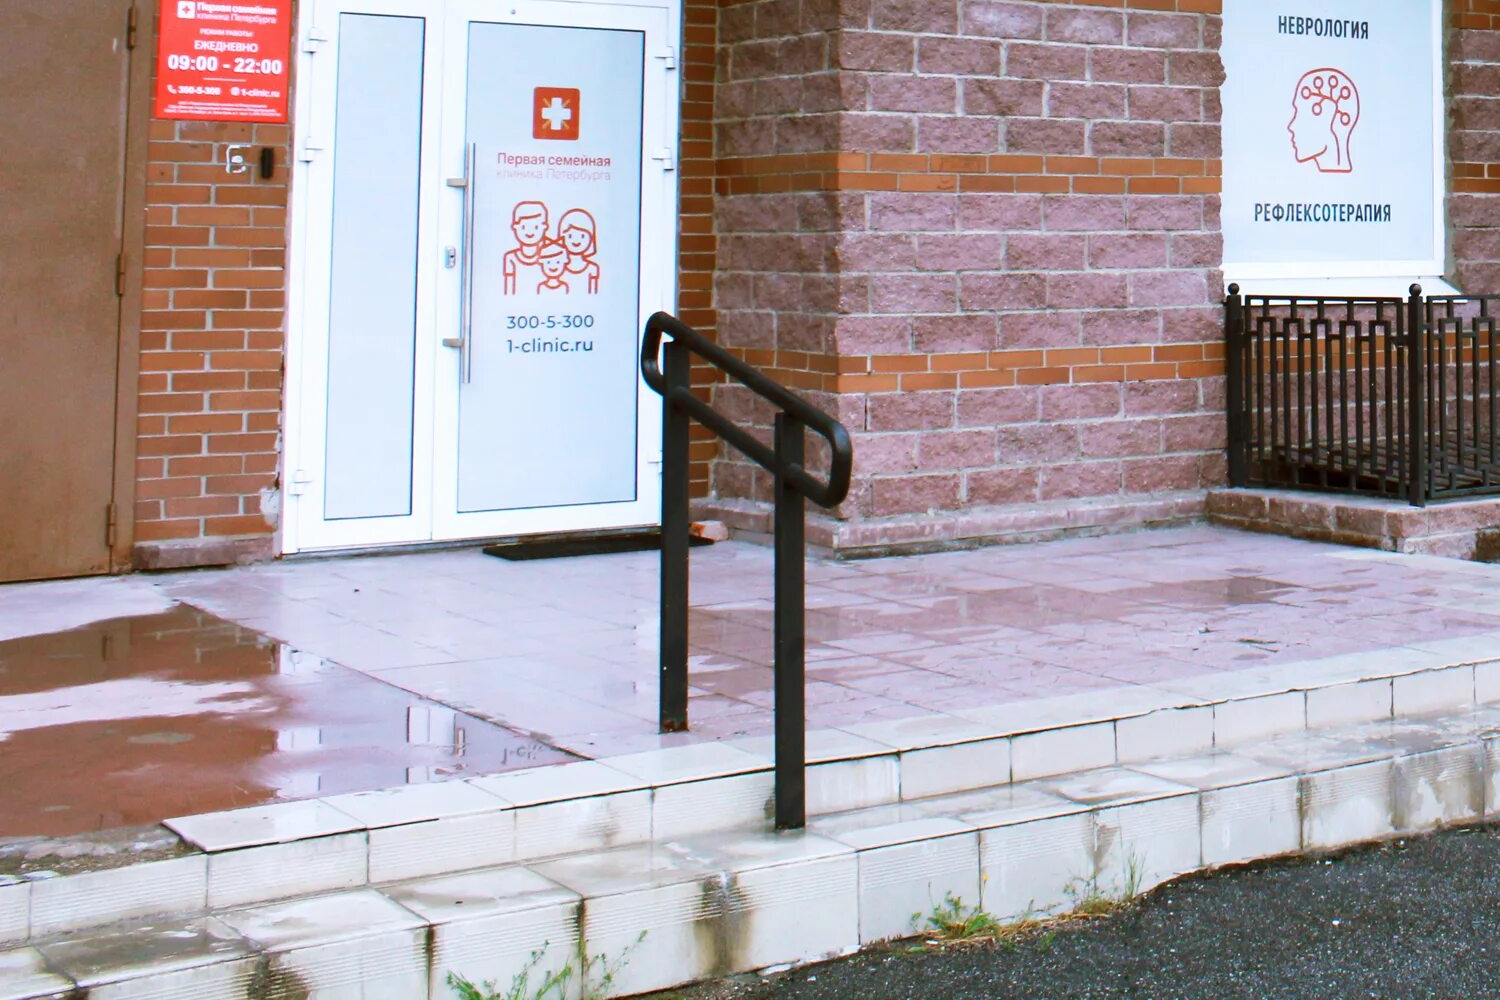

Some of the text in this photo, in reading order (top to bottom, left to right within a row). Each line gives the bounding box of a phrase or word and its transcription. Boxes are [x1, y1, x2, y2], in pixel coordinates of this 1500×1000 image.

[1278, 15, 1369, 40] НЕВРОЛОГИЯ
[194, 40, 259, 54] ЕЖЕДНЕВНО
[167, 54, 219, 72] 09:00
[233, 57, 283, 75] 22:00
[497, 152, 612, 168] Первая семейная
[1254, 202, 1391, 223] РЕФЛЕКСОТЕРАПИЯ
[506, 314, 594, 329] 300-5-300
[506, 337, 594, 353] 1-clinic.ru
